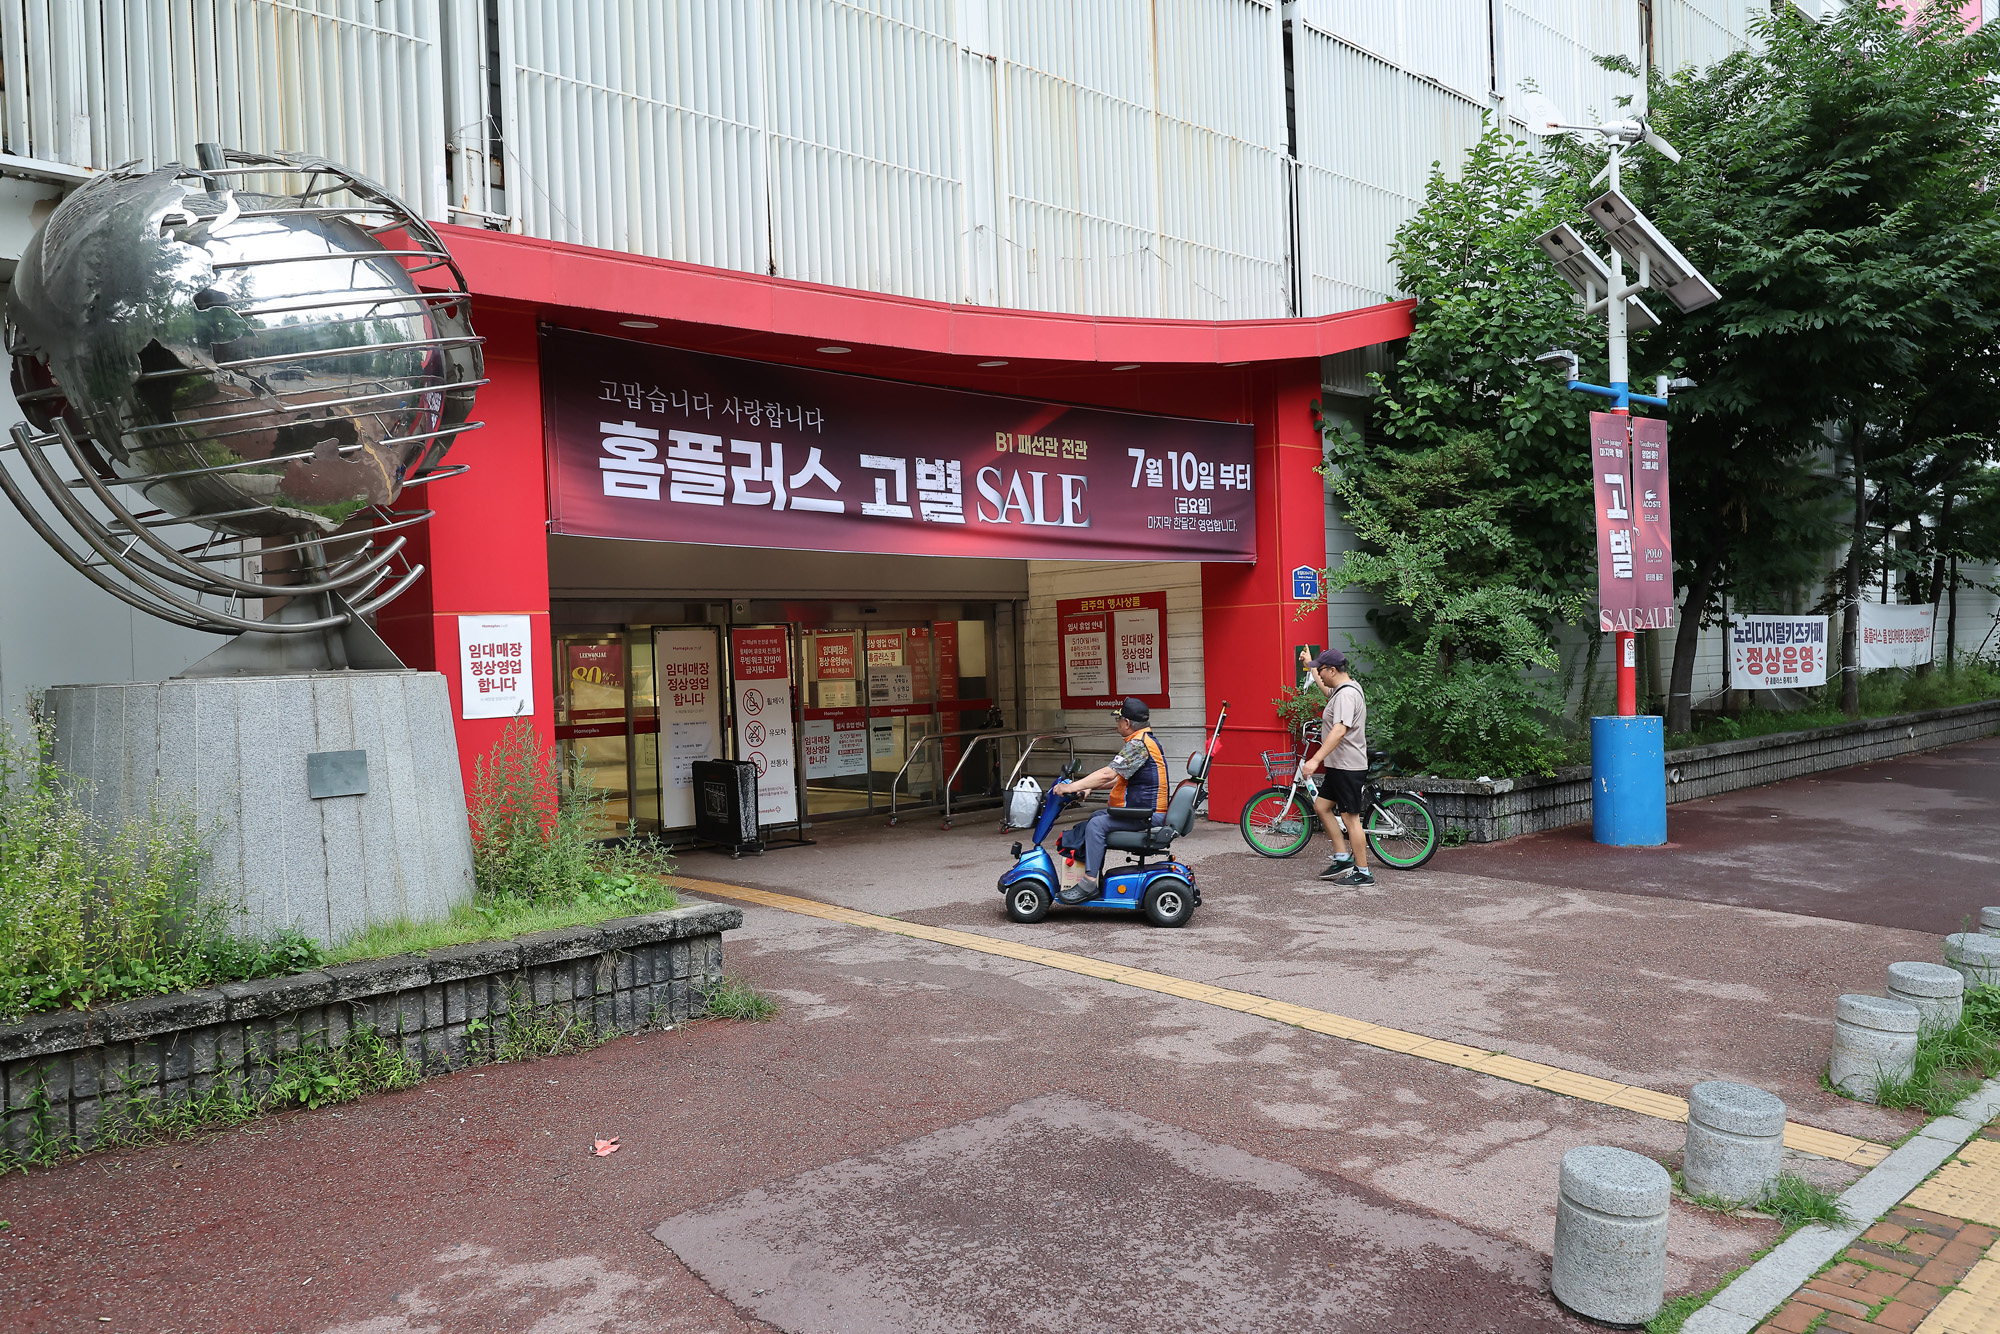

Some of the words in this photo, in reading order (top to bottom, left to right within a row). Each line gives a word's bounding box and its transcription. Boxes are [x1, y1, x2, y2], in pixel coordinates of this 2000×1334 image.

[598, 379, 714, 421] 고맙습니다
[721, 396, 825, 434] 사랑합니다
[995, 431, 1013, 453] B1
[1018, 434, 1059, 459] 패션관
[1062, 438, 1088, 461] 전관
[1599, 447, 1615, 458] 마지막
[599, 420, 845, 513] 홈플러스
[859, 453, 966, 525] 고별
[1127, 448, 1164, 488] 7월
[1167, 451, 1215, 491] 10일
[1220, 462, 1251, 491] 부터
[976, 466, 1091, 528] SALE
[1174, 497, 1212, 515] [금요일]
[1148, 516, 1172, 531] 마지막
[1173, 516, 1197, 531] 한달간
[1198, 518, 1238, 533] 영업합니다.
[1604, 473, 1632, 578] 고별
[1646, 548, 1663, 559] POLO
[1300, 582, 1311, 596] 12
[1081, 600, 1105, 611] 금주의
[1107, 596, 1141, 609] 행사상품
[1067, 622, 1078, 632] 임시
[1079, 621, 1090, 631] 휴업
[1091, 620, 1103, 630] 안내
[1734, 621, 1823, 644] 노리디지털키즈카페
[876, 638, 887, 647] 영업
[887, 637, 899, 647] 안내
[1121, 633, 1154, 646] 임대매장
[468, 642, 523, 658] 임대매장
[823, 645, 848, 656] 임대매장은
[1122, 647, 1153, 660] 정상영업
[740, 656, 763, 665] 무빙워크
[763, 655, 782, 664] 진입이
[818, 656, 830, 667] 정상
[1746, 646, 1814, 675] 정상운영
[470, 659, 522, 676] 정상영업
[666, 662, 710, 677] 임대매장
[746, 664, 775, 674] 금지됩니다
[1126, 661, 1150, 674] 합니다
[477, 677, 517, 693] 합니다
[667, 677, 709, 692] 정상영업
[673, 692, 706, 707] 합니다
[766, 696, 785, 706] 휠체어
[1096, 699, 1124, 708] Homeplus
[573, 728, 600, 736] Homeplus
[769, 728, 787, 736] 유모차
[804, 735, 831, 745] 임대매장
[805, 745, 830, 755] 정상영업
[770, 758, 789, 768] 전동차
[808, 755, 828, 764] 합니다
